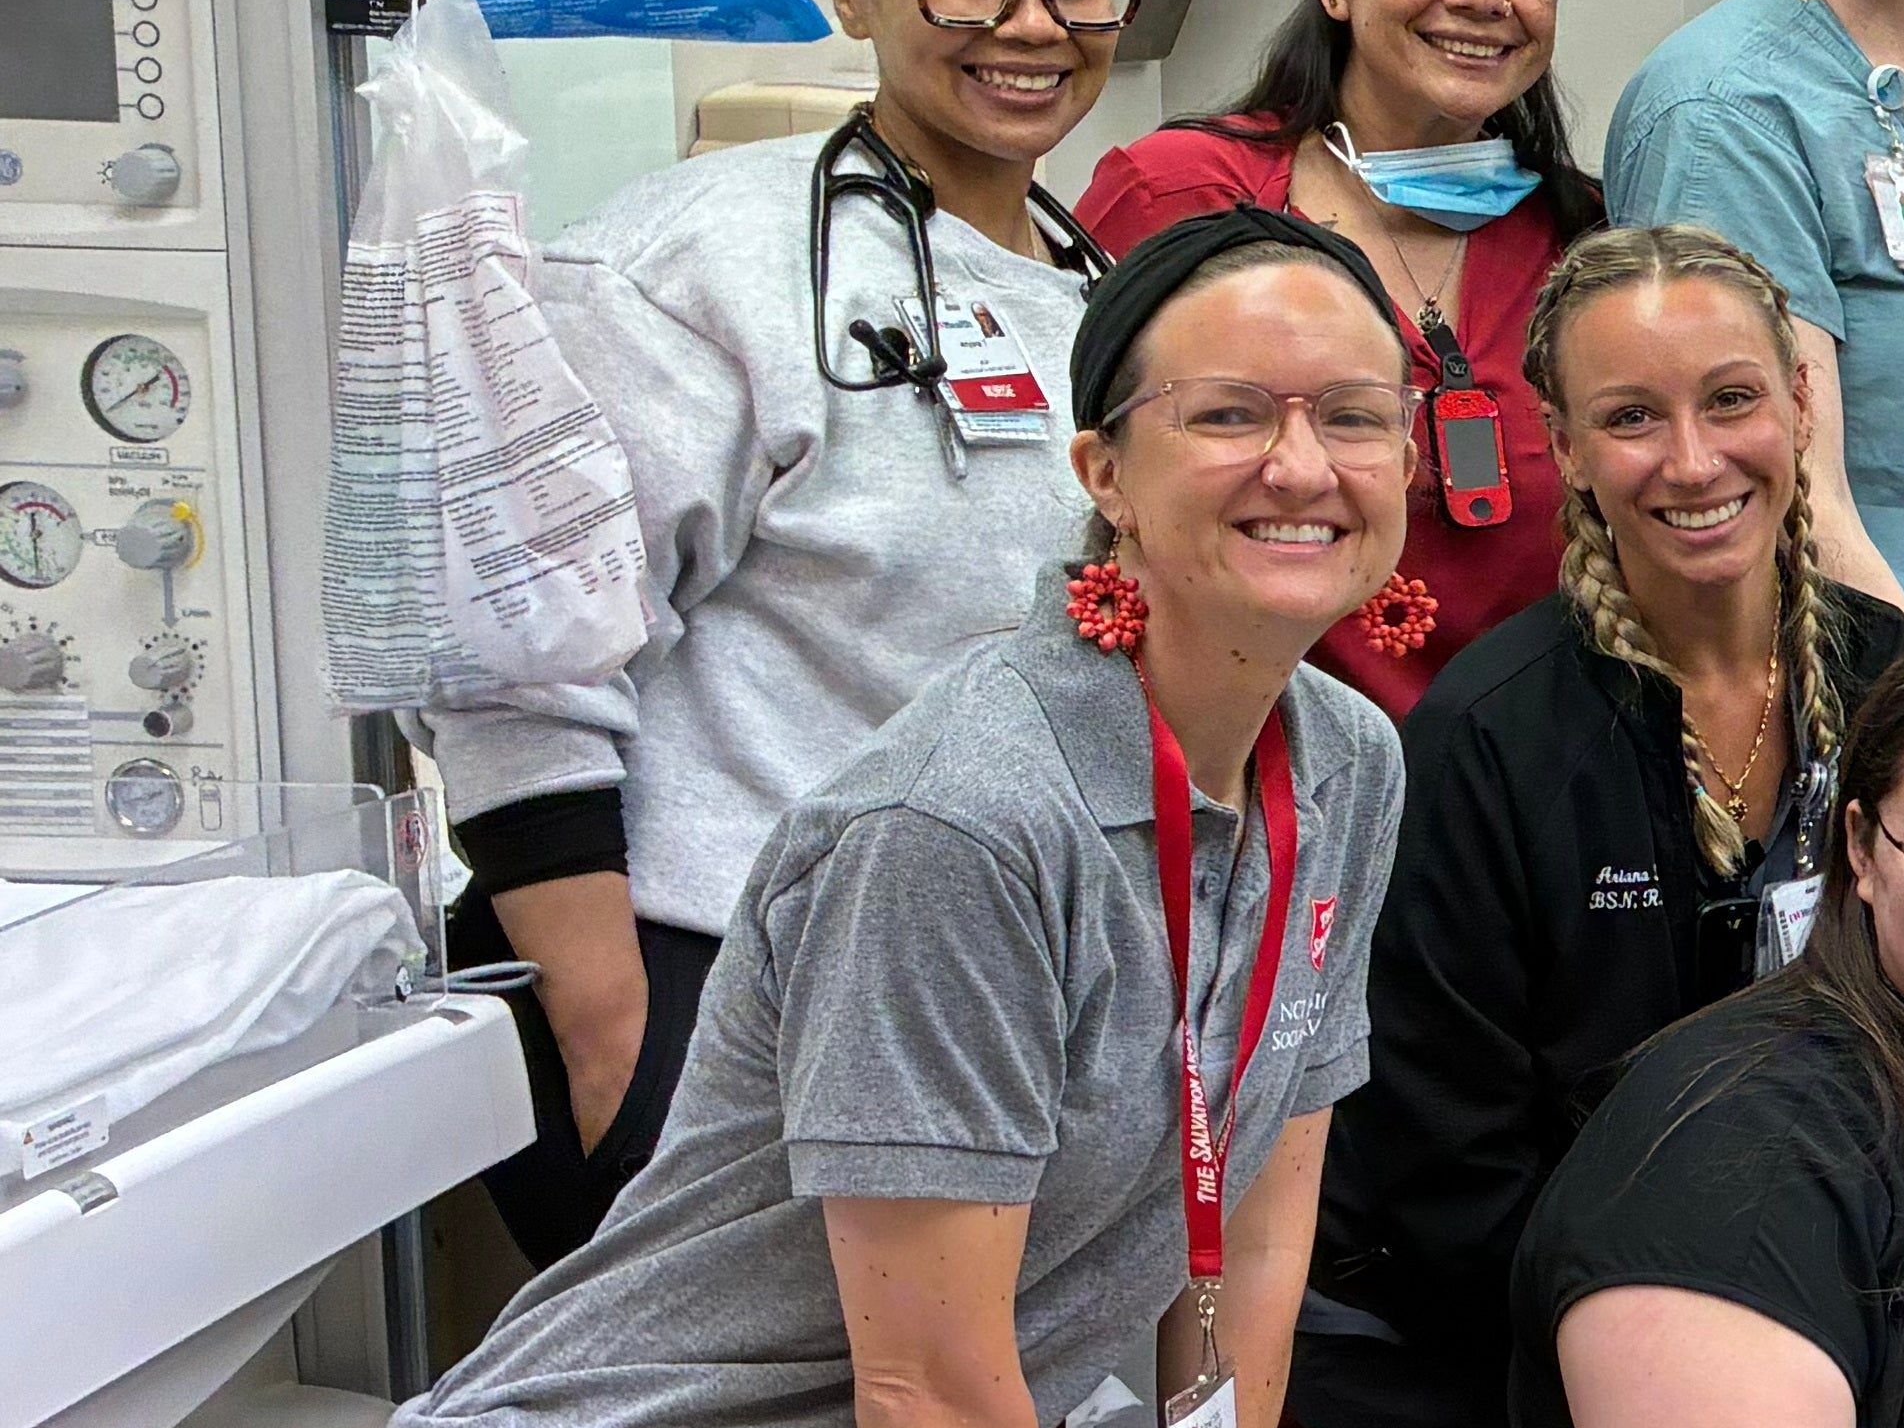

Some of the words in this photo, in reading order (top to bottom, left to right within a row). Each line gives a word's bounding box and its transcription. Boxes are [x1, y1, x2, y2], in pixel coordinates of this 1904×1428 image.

[1595, 865, 1650, 885] Ariana
[1189, 1080, 1216, 1164] SALVATION
[1196, 1164, 1218, 1204] THE
